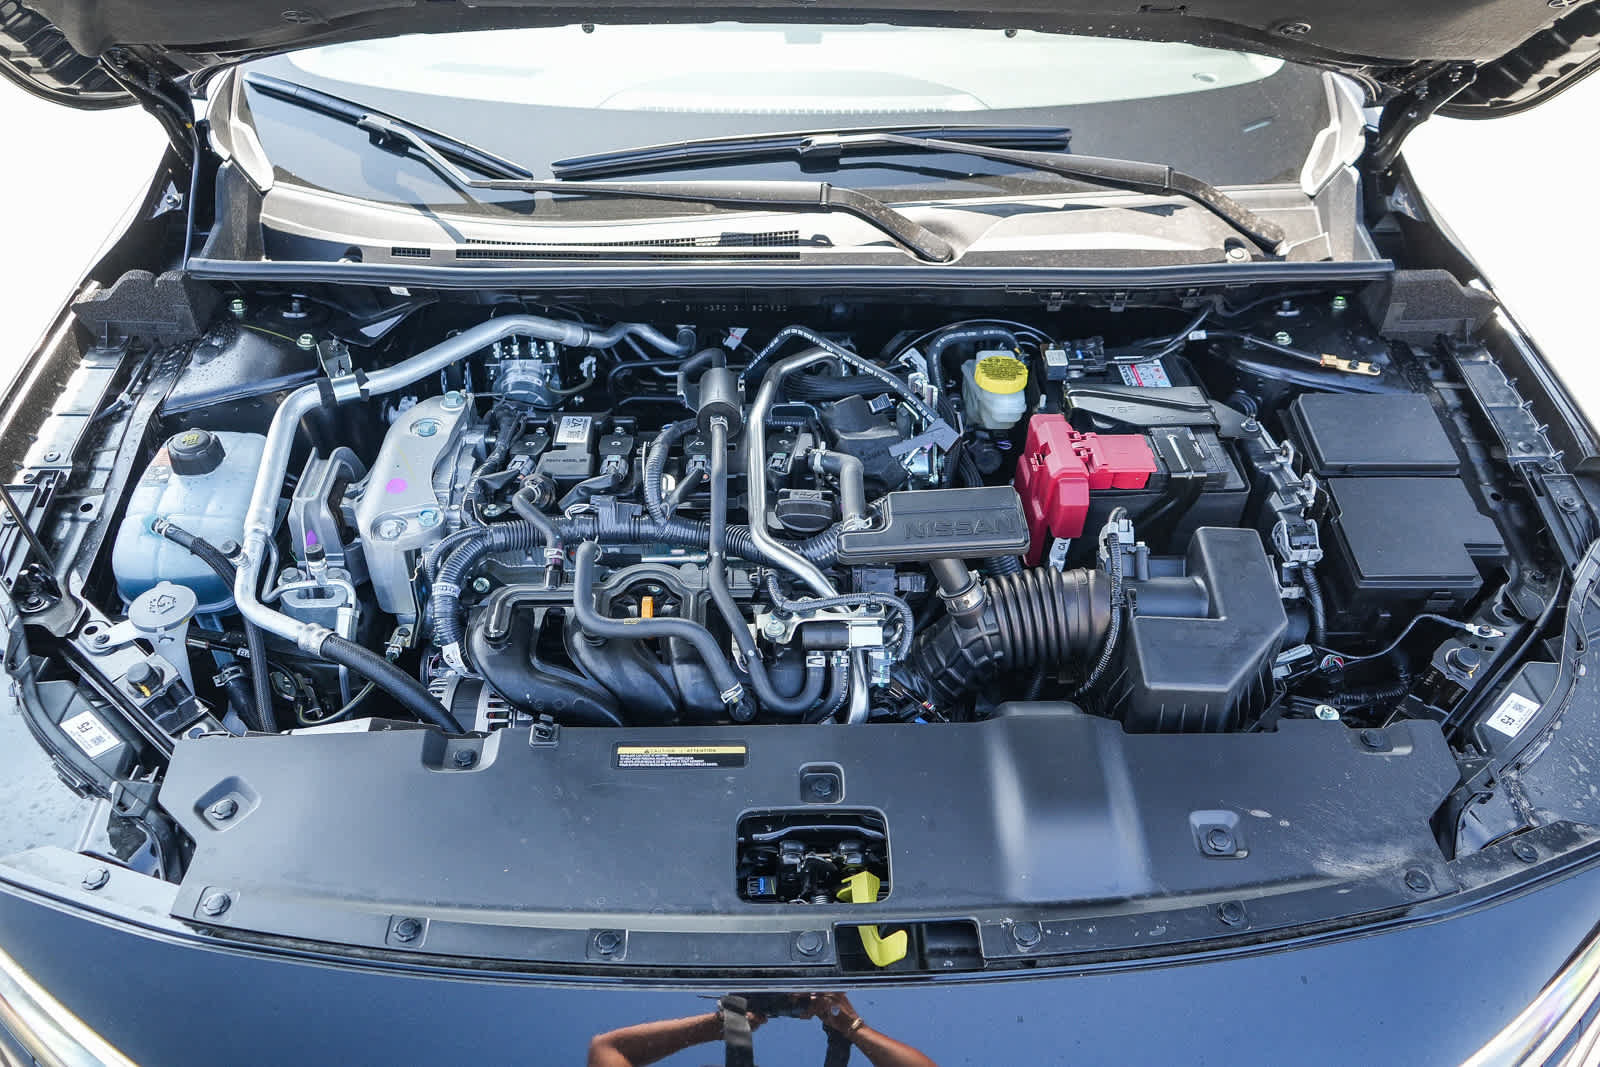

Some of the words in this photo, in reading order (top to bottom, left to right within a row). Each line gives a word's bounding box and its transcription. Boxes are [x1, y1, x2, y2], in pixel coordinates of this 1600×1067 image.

[903, 517, 1018, 539] NISSAN
[1500, 715, 1515, 726] F5
[76, 721, 94, 733] F5
